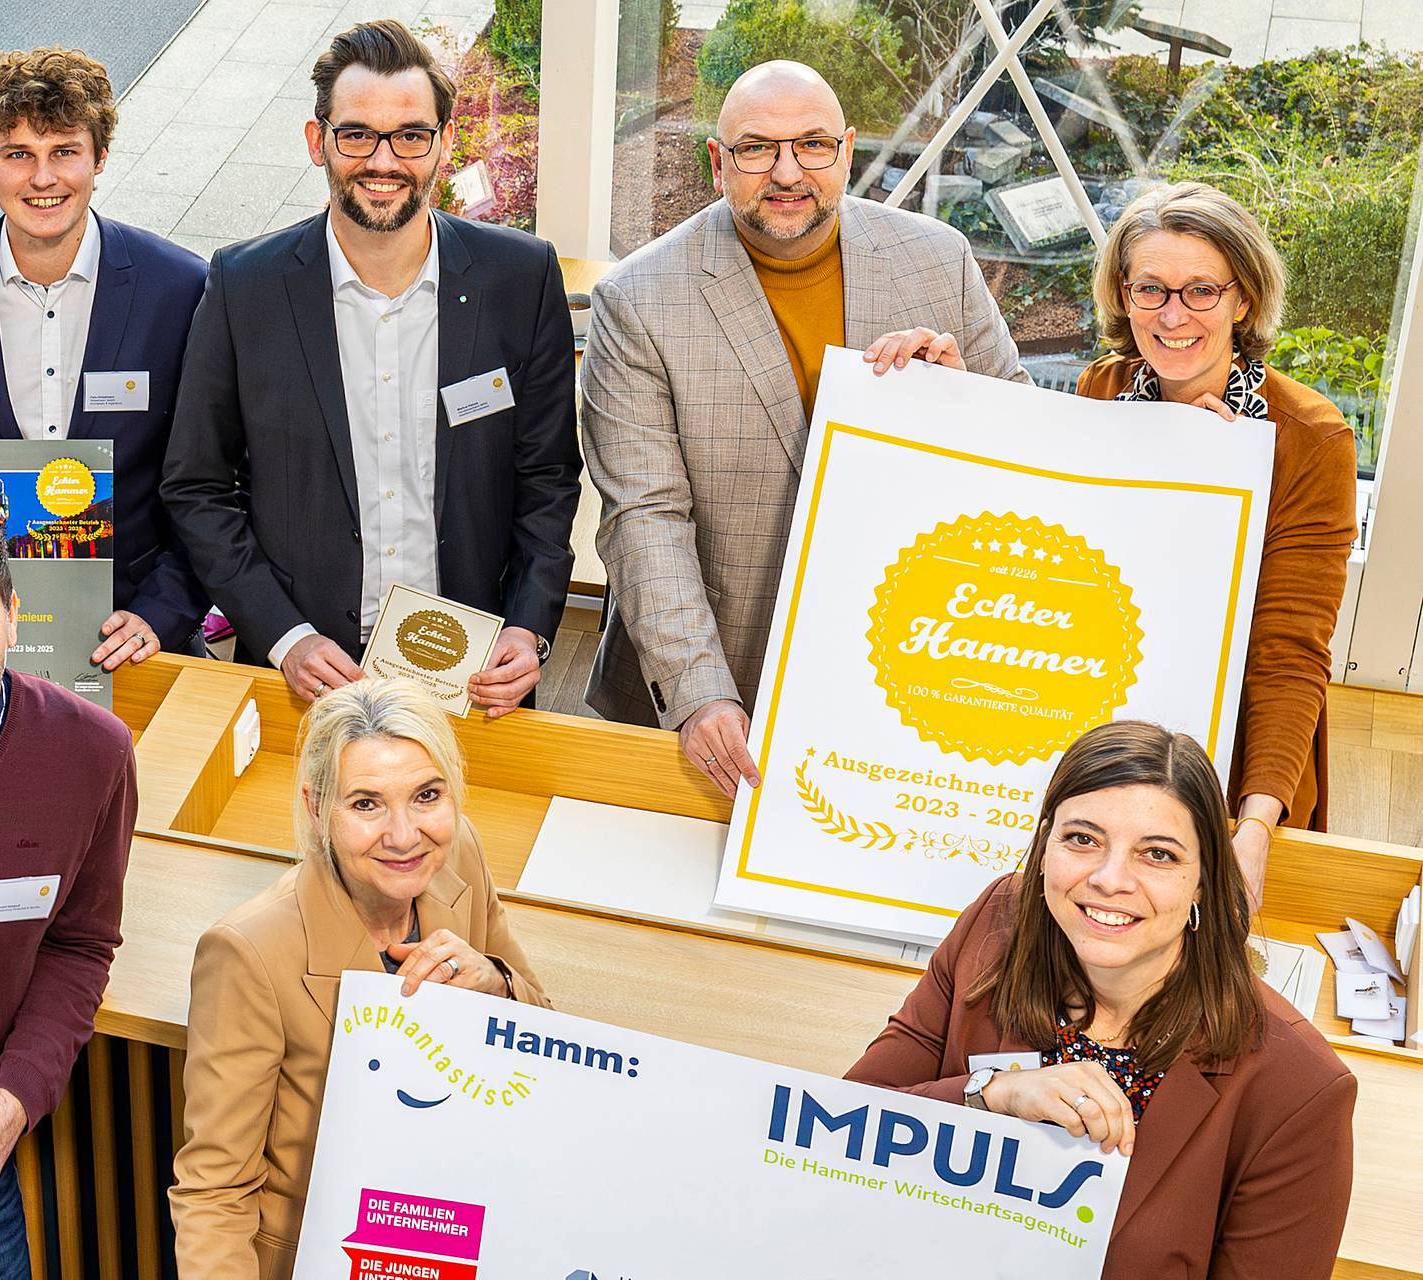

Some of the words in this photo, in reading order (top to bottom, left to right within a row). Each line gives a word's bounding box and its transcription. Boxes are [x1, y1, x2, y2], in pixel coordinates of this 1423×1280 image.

[43, 485, 88, 496] Hammer
[52, 476, 80, 485] Echter
[990, 565, 1008, 576] seit
[1009, 566, 1038, 580] 1226
[17, 612, 53, 623] enieure
[946, 582, 1074, 630] Echter
[404, 632, 458, 656] Hammer
[418, 626, 451, 643] Echter
[25, 644, 35, 652] bis
[37, 645, 54, 653] 2025
[898, 616, 1108, 679] Hammer
[906, 684, 929, 697] 100
[930, 689, 941, 700] %
[943, 692, 1018, 713] GARANTIERTE
[1019, 704, 1075, 721] QUALITÄT
[823, 751, 1034, 803] Ausgezeichneter
[895, 793, 960, 818] 2023
[986, 808, 1035, 832] 202
[485, 1016, 639, 1078] Hamm:
[368, 1198, 390, 1212] DIE
[394, 1202, 455, 1221] FAMILIEN
[763, 1148, 796, 1170] Die
[802, 1154, 888, 1191] Hammer
[894, 1179, 1088, 1250] Wirtschaftsagentur
[366, 1212, 469, 1237] UNTERNEHMER
[360, 1258, 382, 1272] DIE
[385, 1262, 440, 1280] JUNGEN
